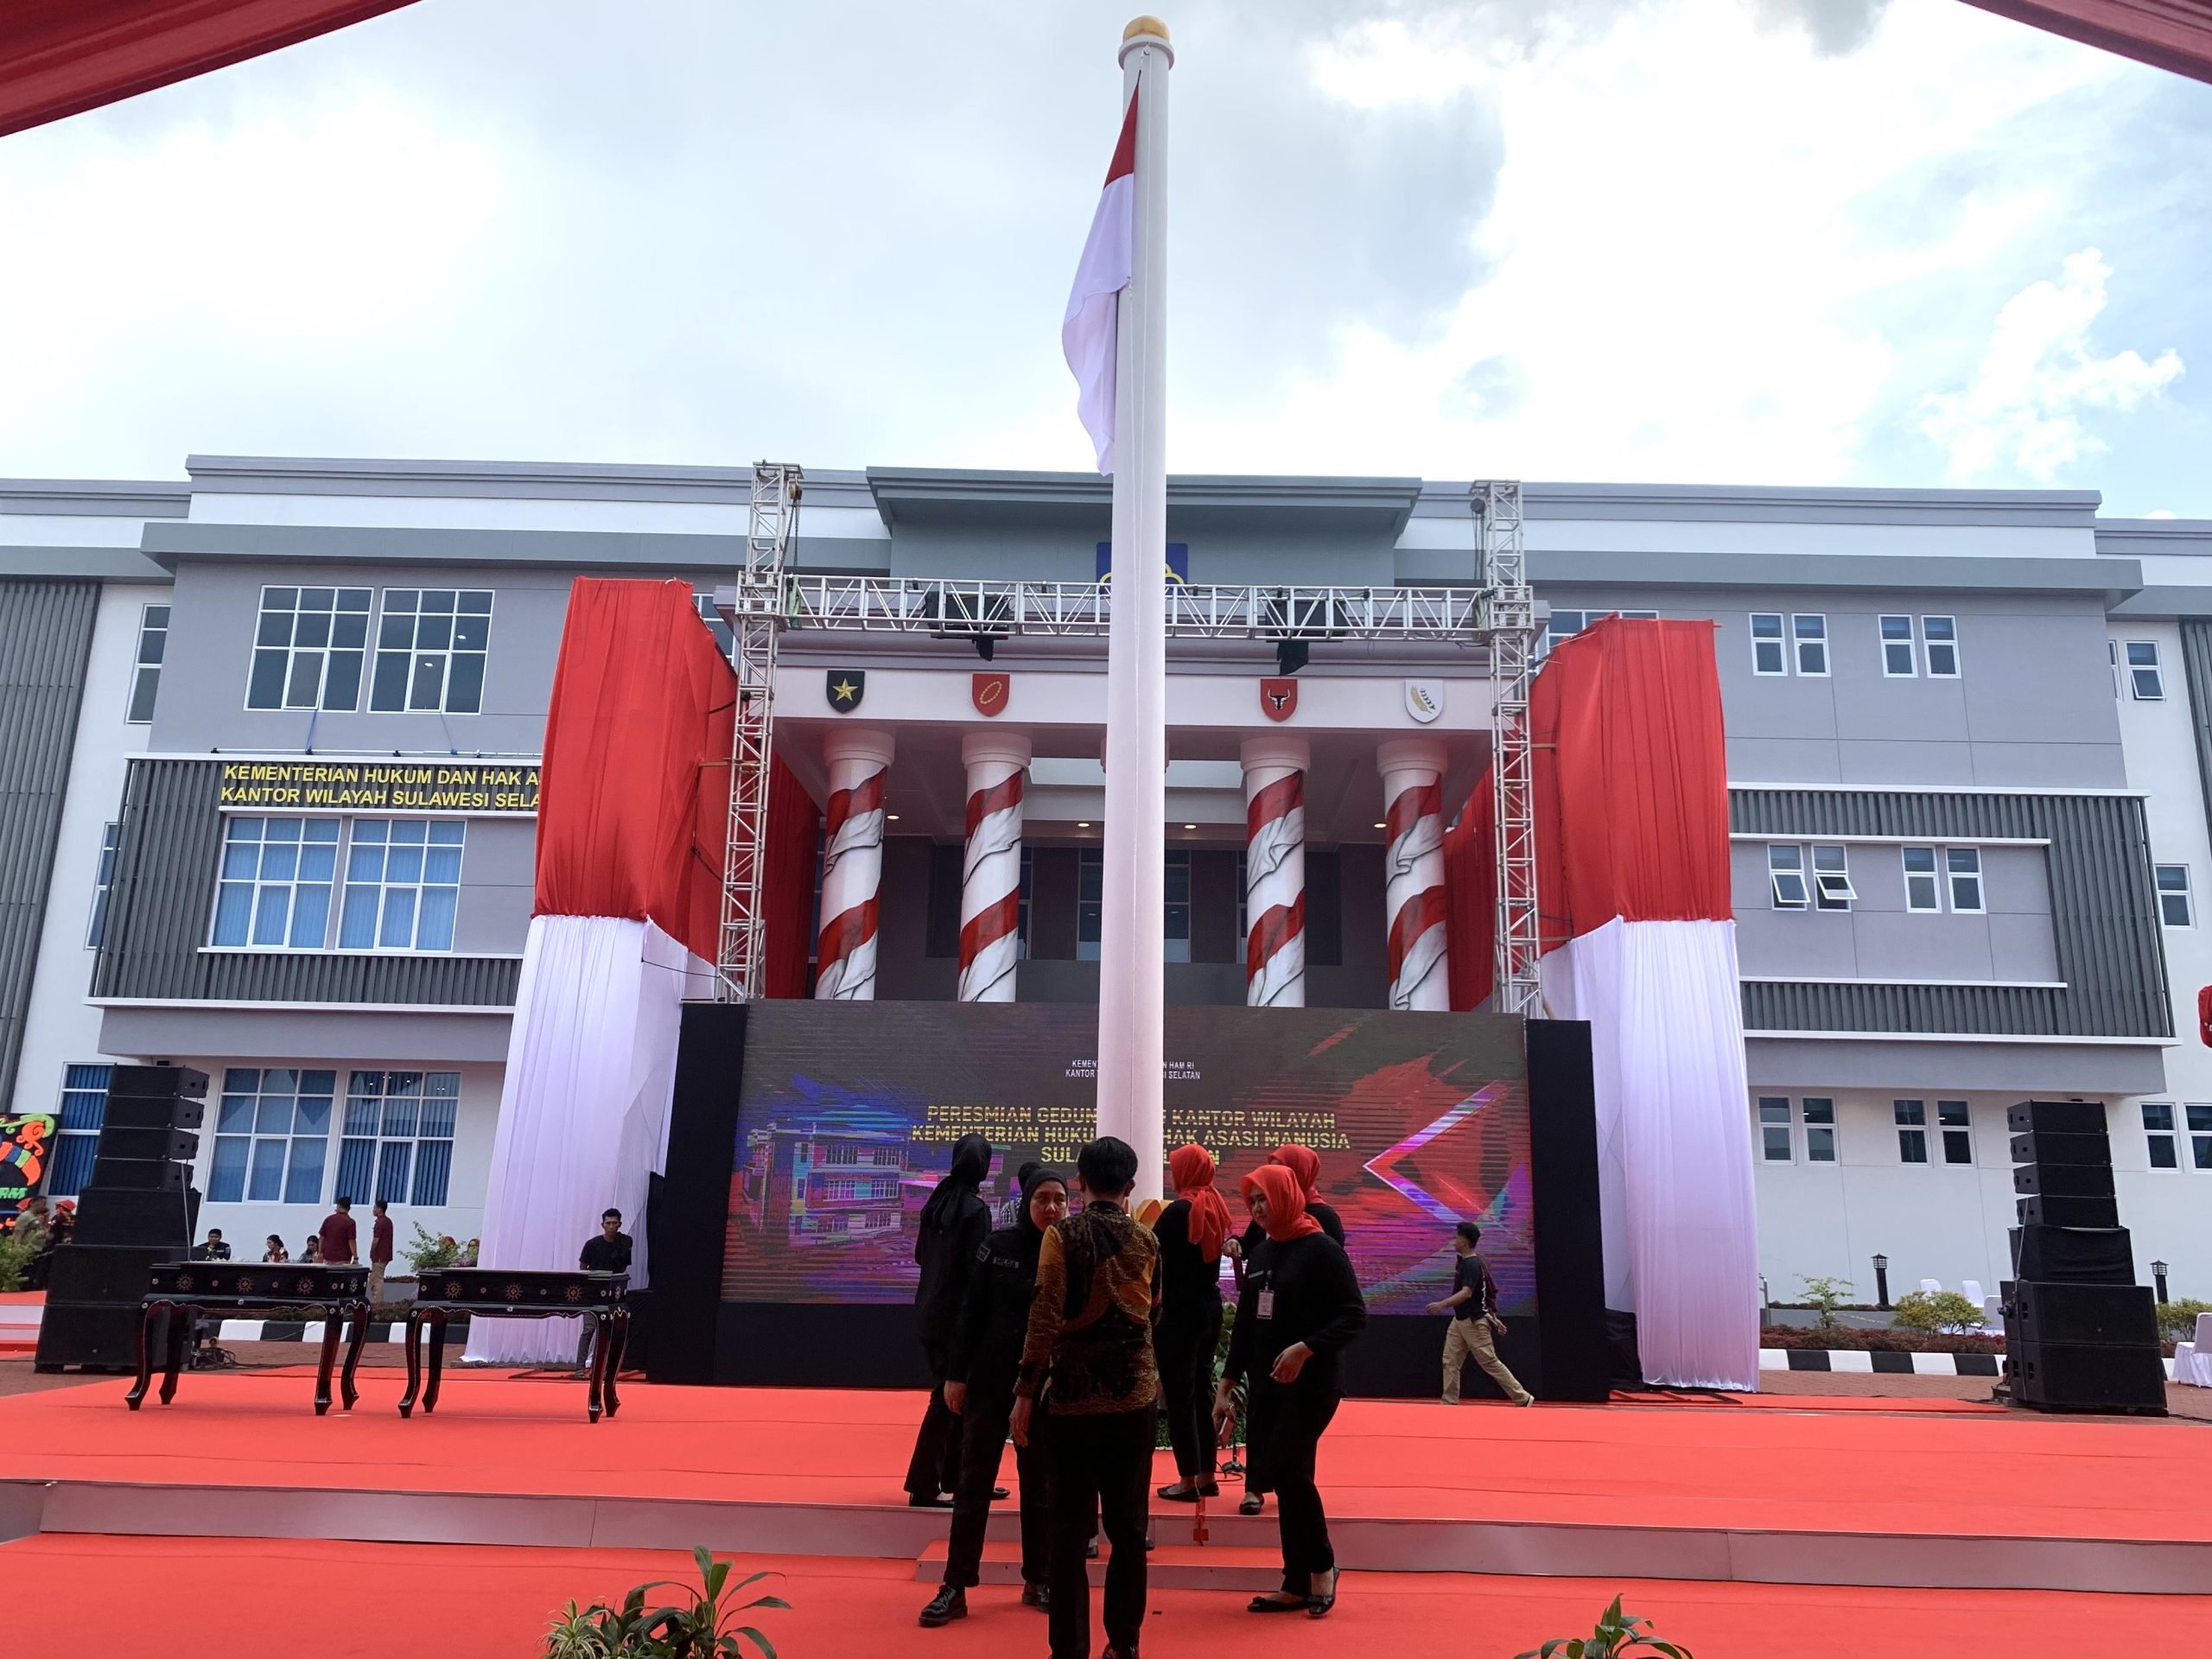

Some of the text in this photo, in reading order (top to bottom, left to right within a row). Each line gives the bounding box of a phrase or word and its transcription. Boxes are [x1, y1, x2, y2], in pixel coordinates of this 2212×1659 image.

[224, 766, 541, 785] KEMENTERIAN HUKUM DAN HAK A
[220, 787, 539, 808] KANTOR WILAYAH SULAWESI SELA
[1065, 1069, 1095, 1077] KANTOR
[1168, 1071, 1200, 1079] SELATAN
[1071, 1059, 1098, 1068] KEMEN
[1169, 1061, 1185, 1070] HAM
[927, 1105, 1032, 1122] PERESMIAN
[1037, 1107, 1097, 1123] GEDUN
[1172, 1109, 1246, 1127] KANTOR
[1251, 1111, 1335, 1128] WILAYAH
[912, 1125, 1351, 1149] KEMENTERIAN HUKU HAK ASASI MANUSIA
[1041, 1147, 1082, 1163] SUL
